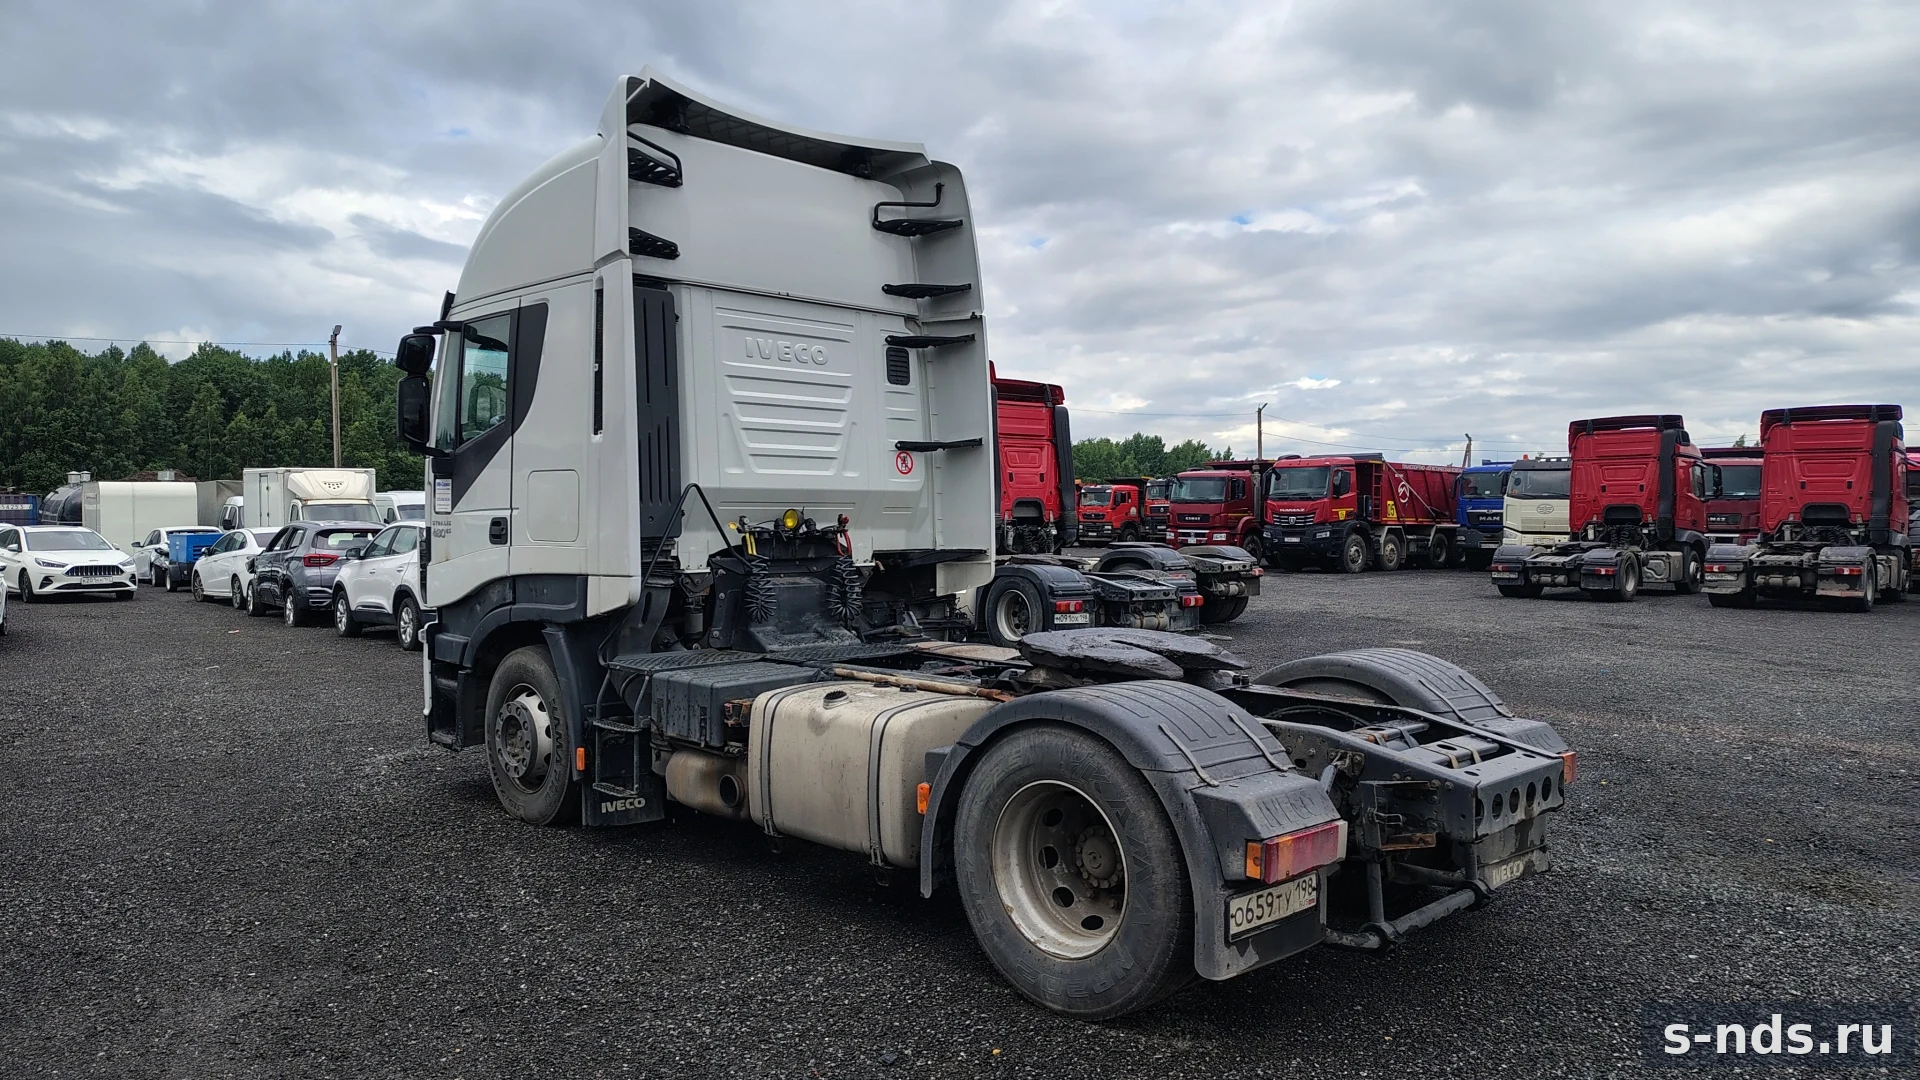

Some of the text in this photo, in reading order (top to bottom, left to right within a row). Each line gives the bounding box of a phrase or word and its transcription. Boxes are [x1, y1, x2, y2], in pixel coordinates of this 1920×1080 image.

[745, 337, 828, 365] IVECO
[601, 797, 646, 814] IVECO
[1234, 877, 1313, 927] О659ТУ 198
